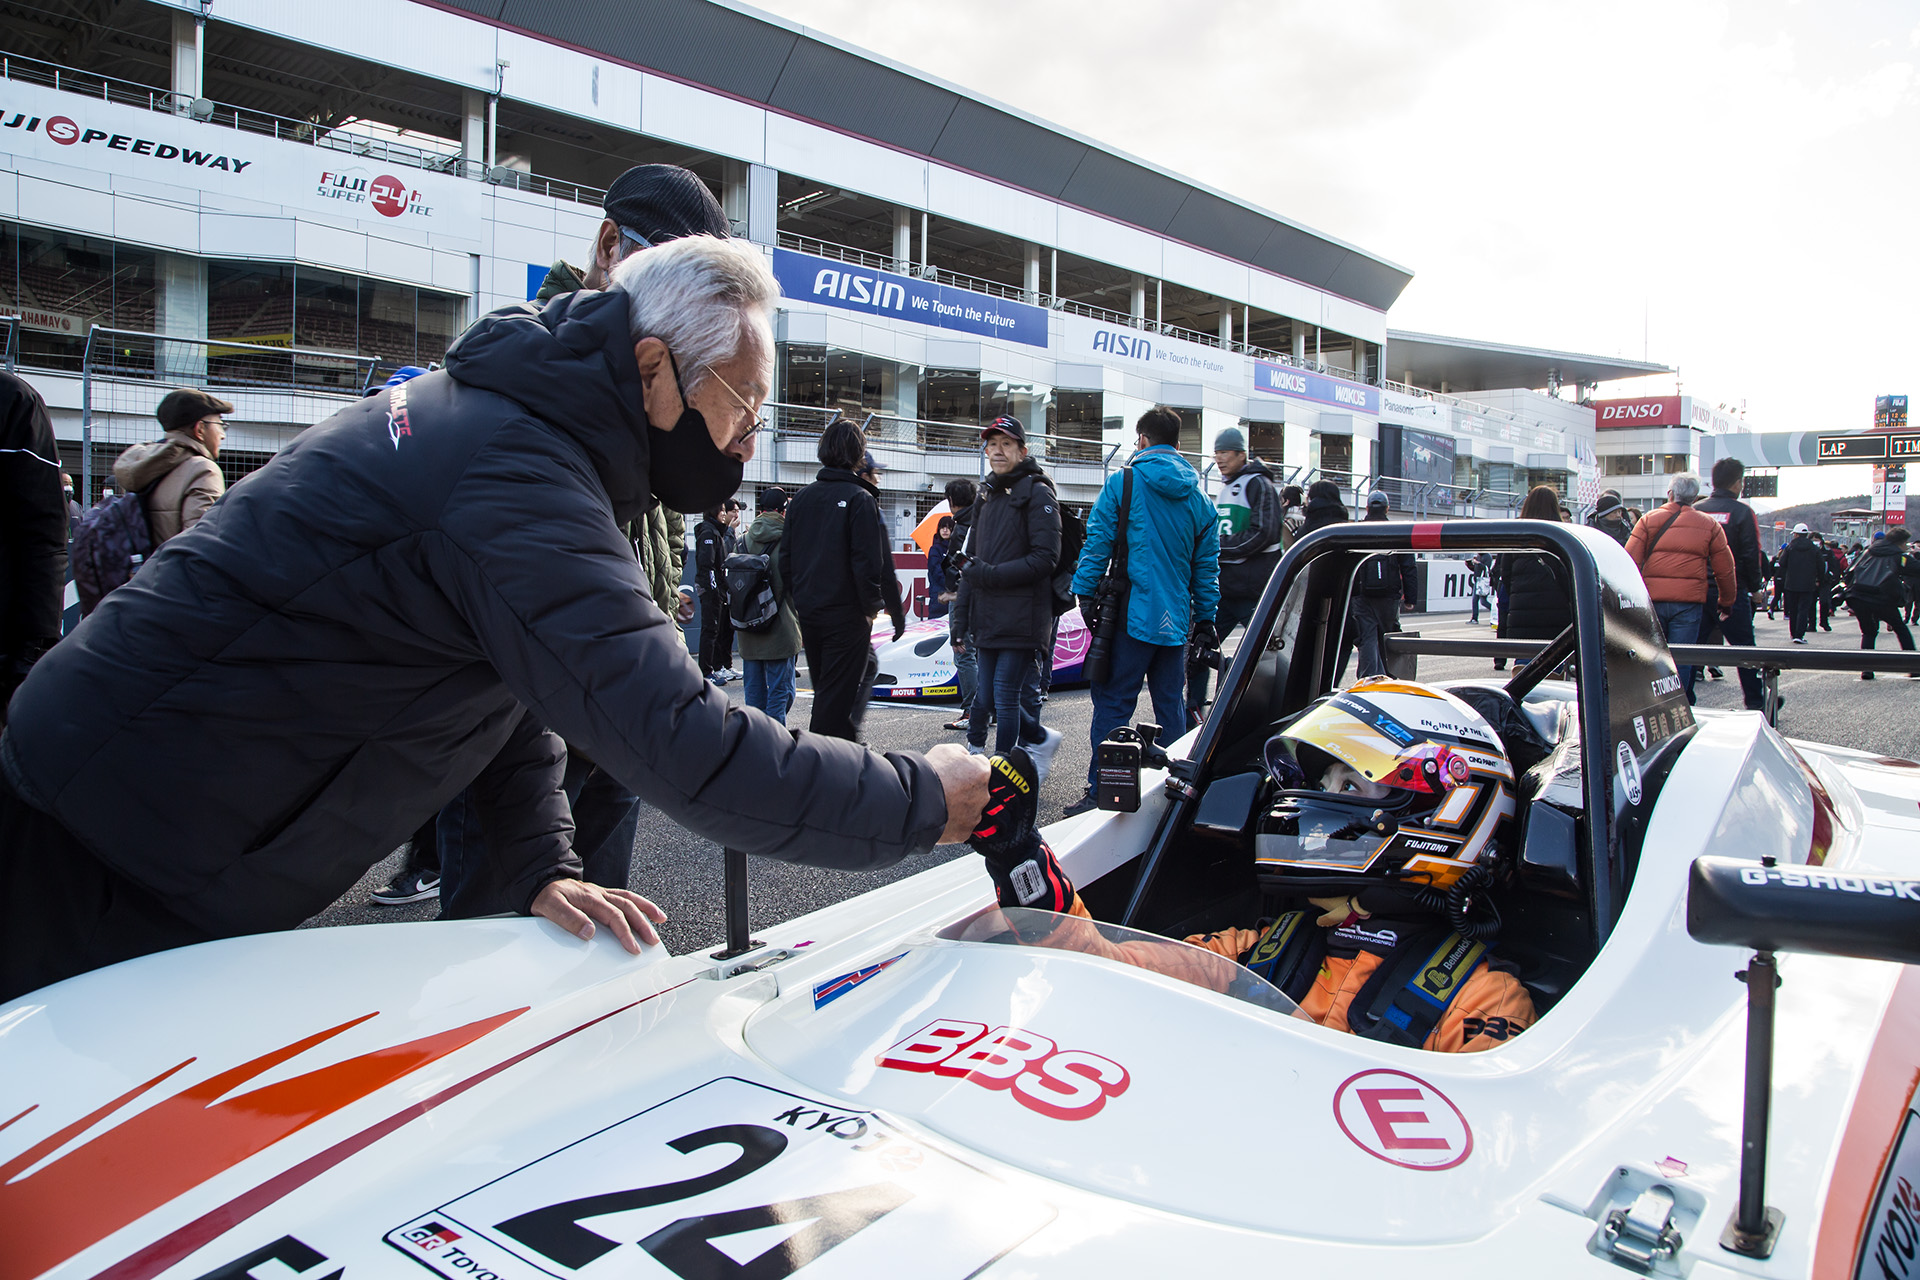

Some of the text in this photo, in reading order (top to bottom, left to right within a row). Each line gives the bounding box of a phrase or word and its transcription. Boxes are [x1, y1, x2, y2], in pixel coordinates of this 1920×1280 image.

[46, 116, 252, 174] SPEEDWAY
[320, 171, 368, 192] FUJI
[316, 186, 366, 204] SUPER
[409, 203, 434, 217] TEC
[812, 268, 1016, 328] AISIN We Touch the Future
[1092, 330, 1224, 373] AISIN We Touch the Future
[1270, 369, 1306, 393] WAKO'S
[1335, 385, 1366, 407] WAKO'S
[1384, 398, 1415, 416] Panasonic
[1602, 403, 1663, 420] DENSO
[1821, 442, 1847, 455] LAP
[892, 688, 916, 696] MOTUL
[1421, 719, 1453, 732] ENGINE
[1454, 724, 1469, 736] FOR
[1469, 727, 1482, 737] THE
[1405, 839, 1448, 853] FUJITOMO
[1740, 868, 1920, 902] G-SHOCK
[874, 1018, 1131, 1122] BBS
[1355, 1088, 1452, 1150] E
[492, 1124, 918, 1280] 24
